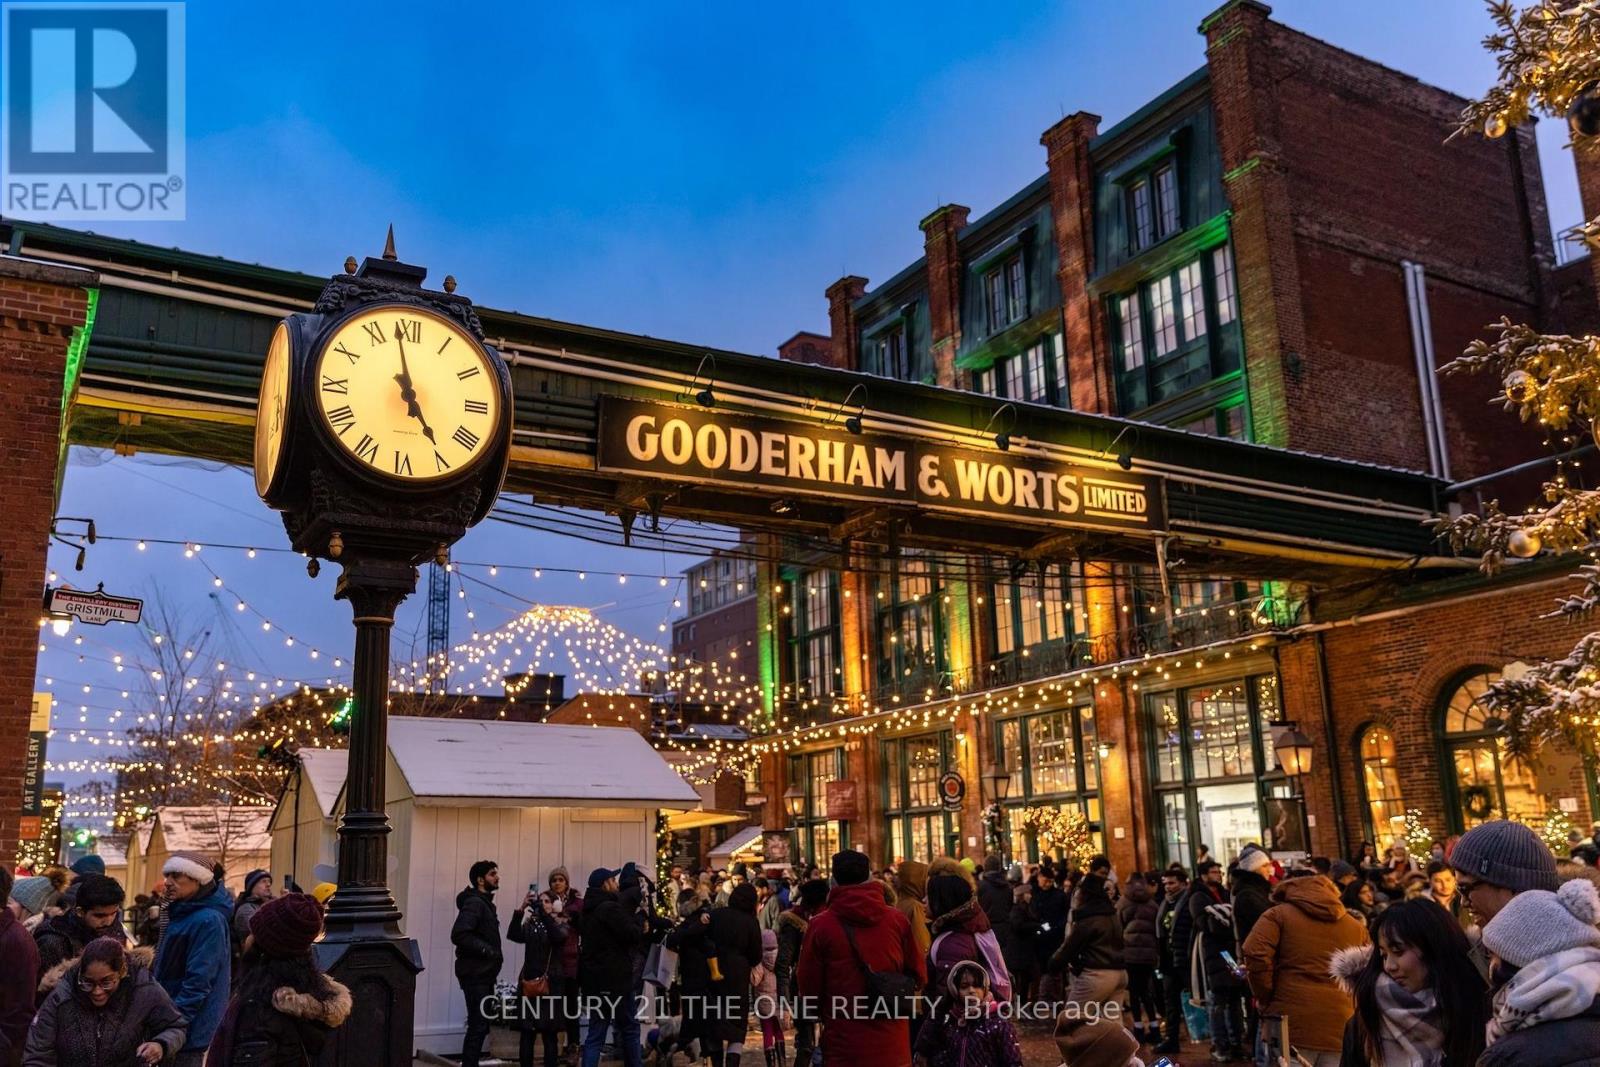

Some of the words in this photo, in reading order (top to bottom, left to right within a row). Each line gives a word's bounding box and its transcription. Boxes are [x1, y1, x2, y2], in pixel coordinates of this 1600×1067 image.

[361, 321, 387, 347] XI
[399, 318, 422, 344] XII
[333, 341, 361, 365] X
[322, 375, 348, 395] IX
[456, 366, 480, 381] II
[464, 399, 488, 415] III
[433, 449, 451, 472] V
[626, 415, 906, 491] GOODERHAM
[918, 455, 950, 498] &
[954, 459, 1080, 514] WORTS
[1083, 485, 1148, 514] LIMITED
[65, 602, 125, 619] GRISTMILL
[72, 596, 107, 606] DISTILLERY
[108, 602, 138, 610] DISTRICT
[26, 737, 40, 785] GALLERY
[24, 789, 35, 810] ART
